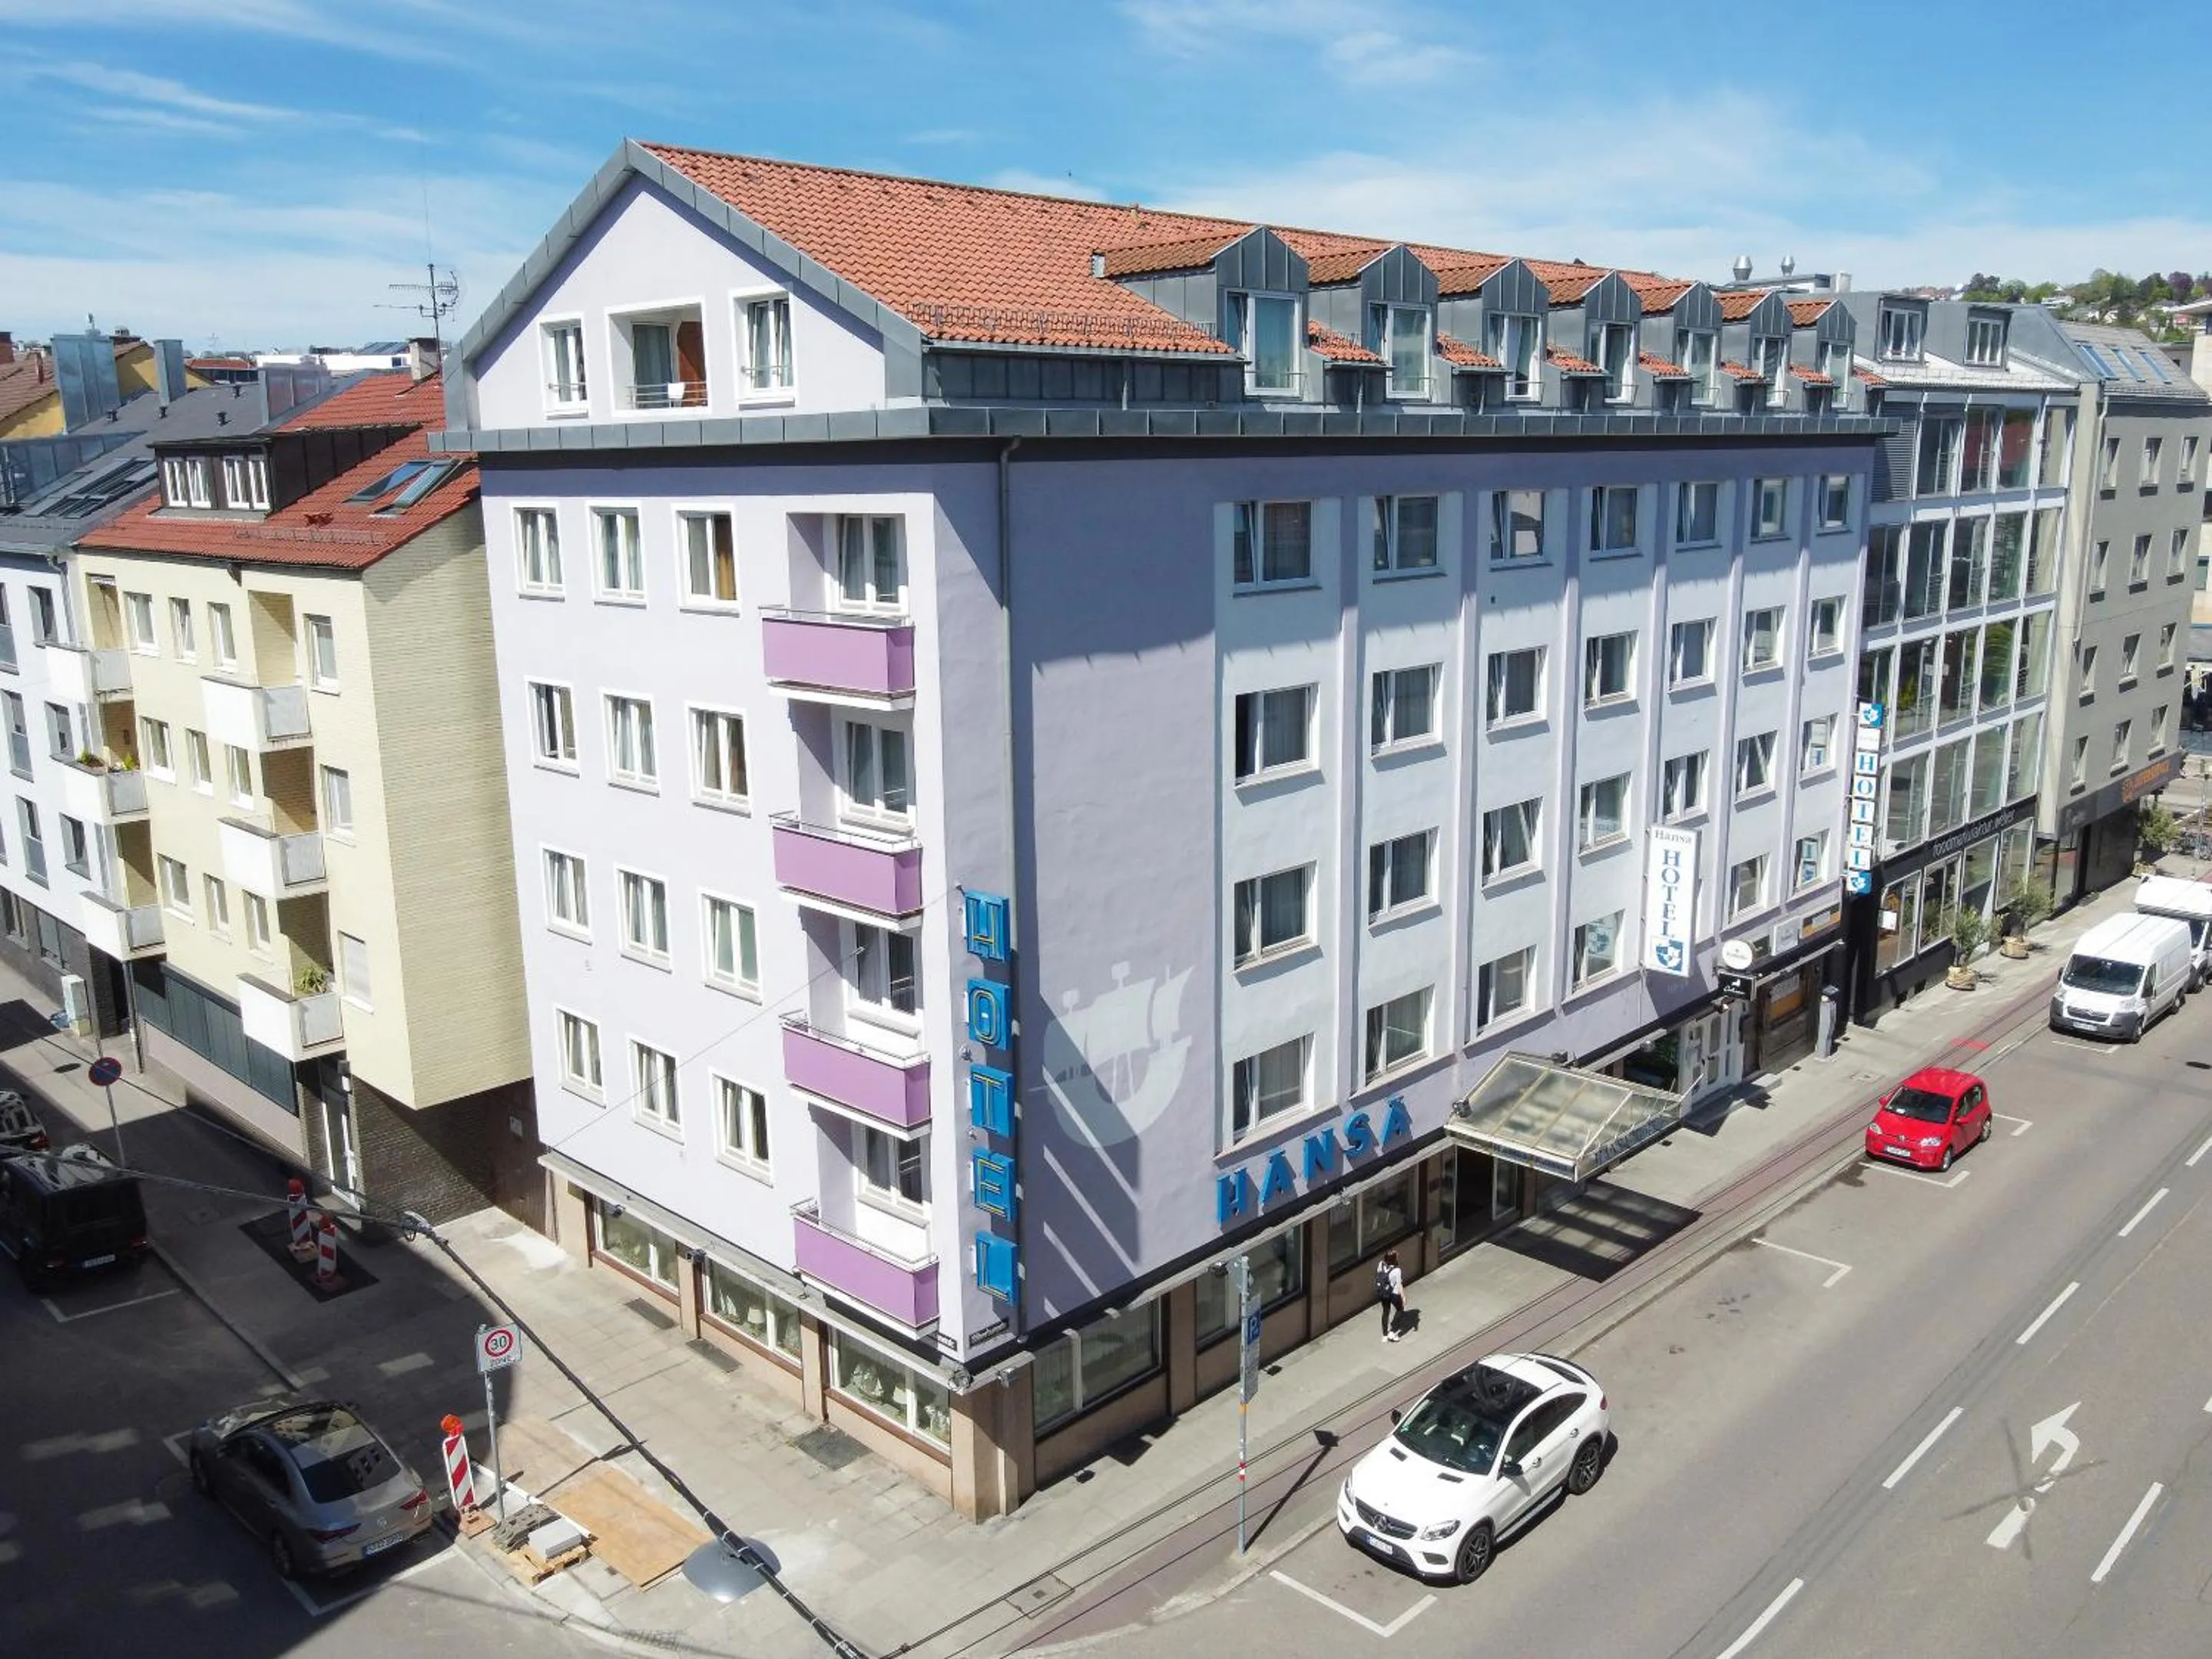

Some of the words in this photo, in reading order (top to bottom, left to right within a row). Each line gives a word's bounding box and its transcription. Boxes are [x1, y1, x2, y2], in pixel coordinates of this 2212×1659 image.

[1854, 755, 1874, 865] HOTEL
[1661, 849, 1681, 938] HOTEL
[965, 890, 1018, 1306] HOTEL
[1217, 1095, 1413, 1229] HANSA
[491, 1336, 507, 1350] 30
